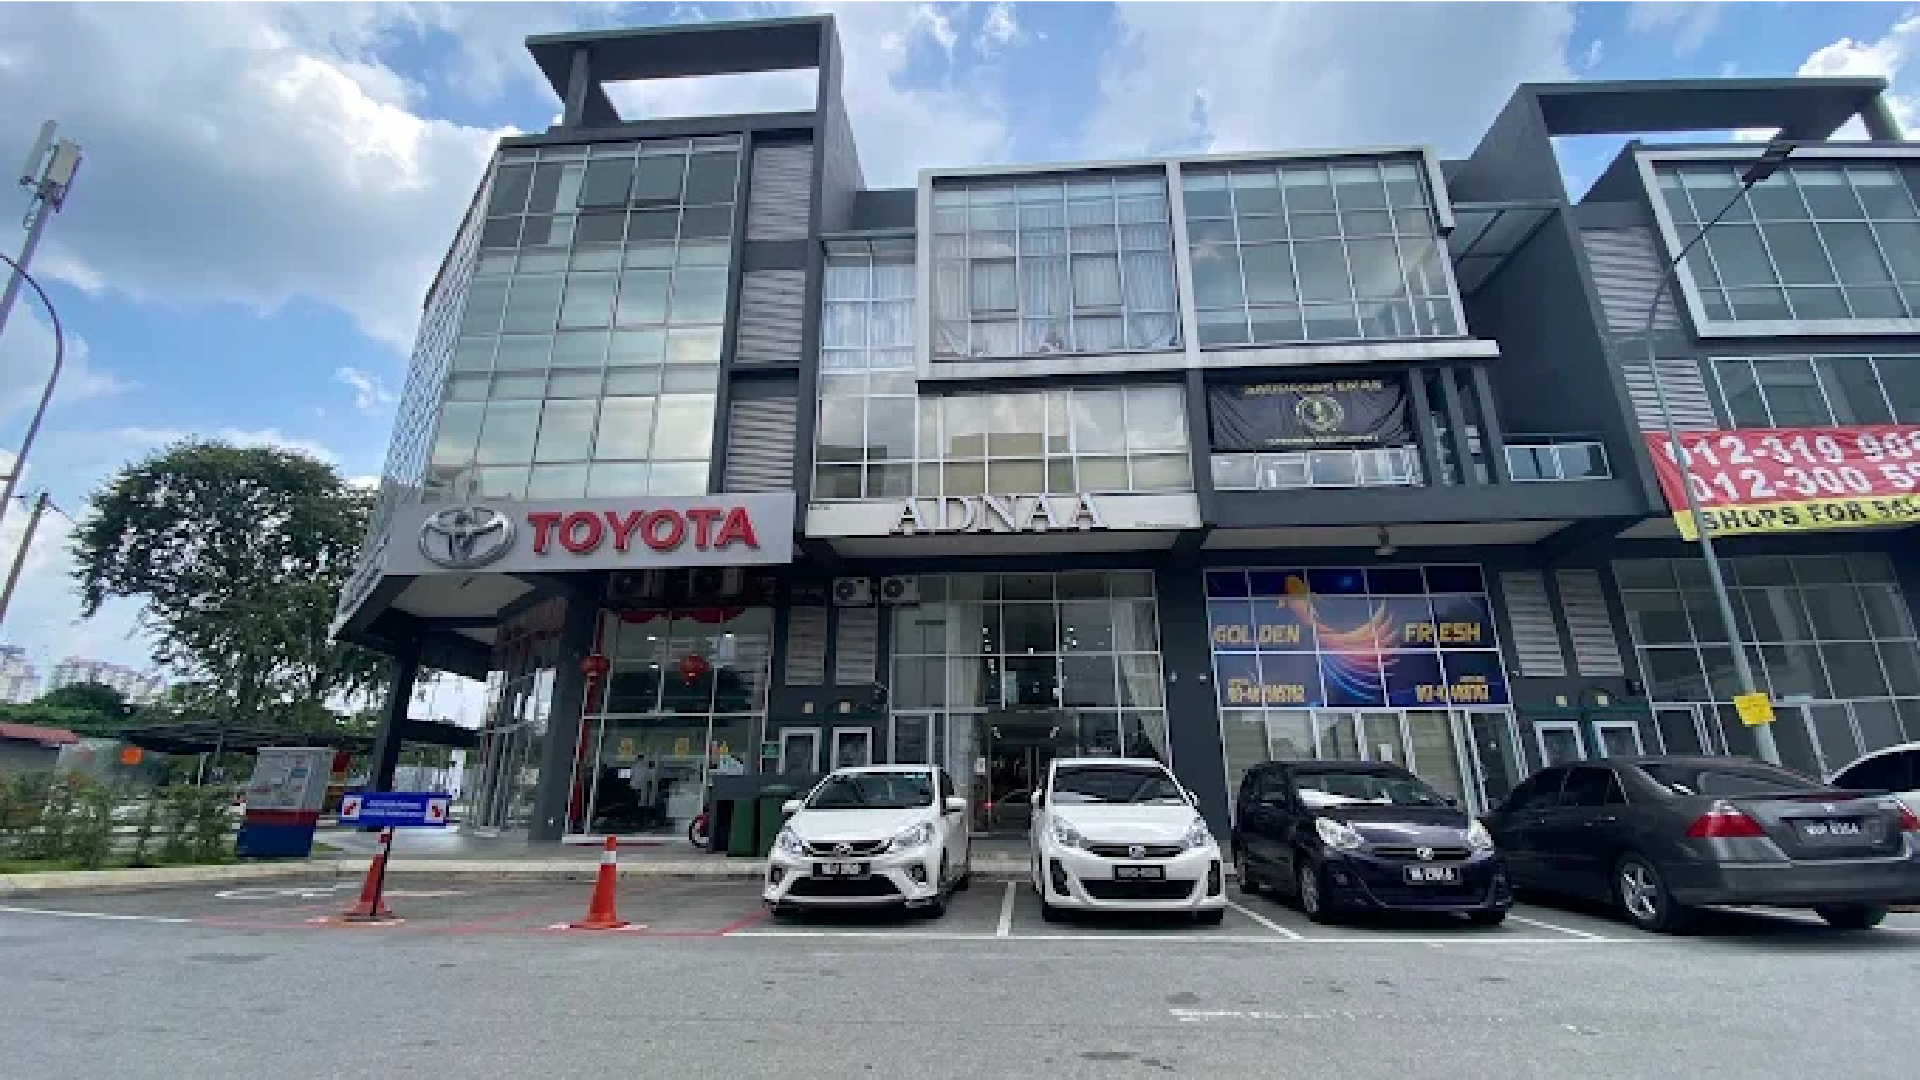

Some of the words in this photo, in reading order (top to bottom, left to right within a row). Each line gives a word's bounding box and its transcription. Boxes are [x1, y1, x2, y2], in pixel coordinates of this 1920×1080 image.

[1687, 466, 1873, 502] 012-300
[526, 507, 760, 554] TOYOTA
[890, 492, 1109, 535] ADNAA
[1702, 507, 1800, 530] SHOPS
[1806, 502, 1868, 523] FOR
